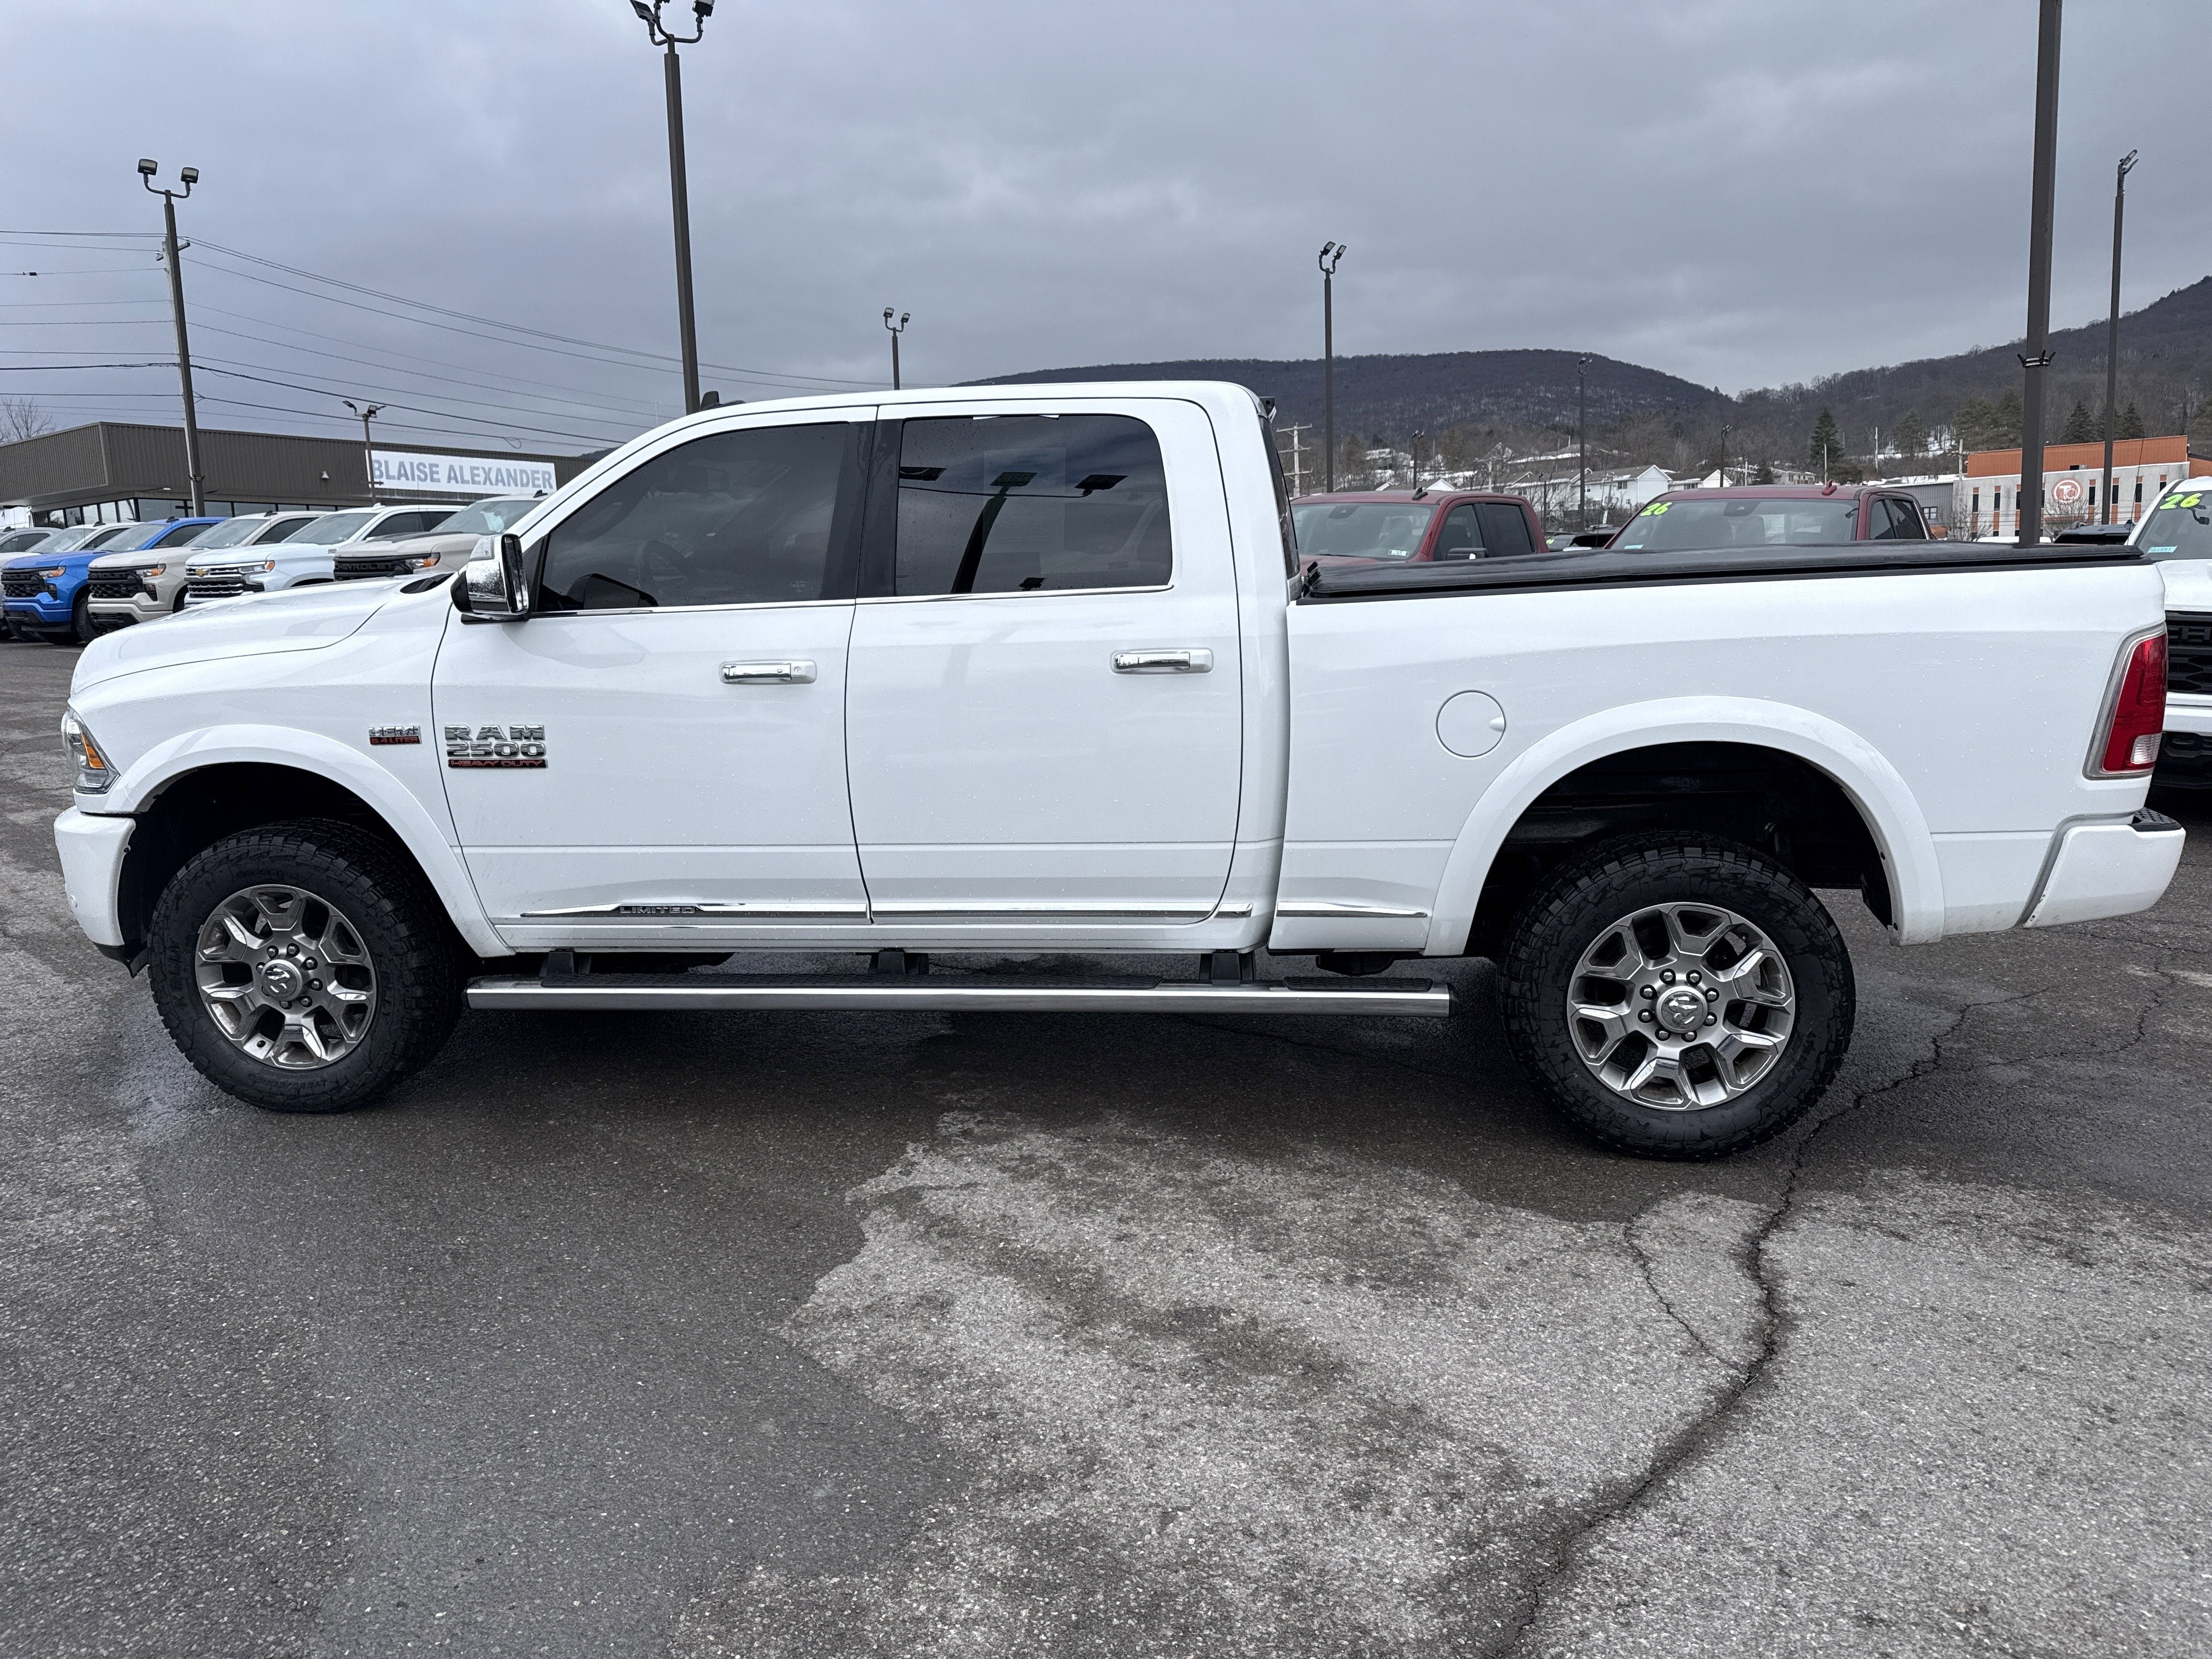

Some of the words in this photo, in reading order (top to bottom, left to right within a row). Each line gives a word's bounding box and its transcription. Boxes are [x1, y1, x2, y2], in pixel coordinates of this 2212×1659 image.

[373, 459, 441, 482] BLAISE
[447, 464, 554, 489] ALEXANDER
[1640, 502, 1673, 516] 26
[2159, 493, 2203, 510] 26
[368, 725, 421, 736] HEMI
[444, 725, 545, 741] RAM
[447, 741, 546, 758] 2500
[166, 937, 188, 1009] KELLY
[1571, 1087, 1652, 1133] KELLY
